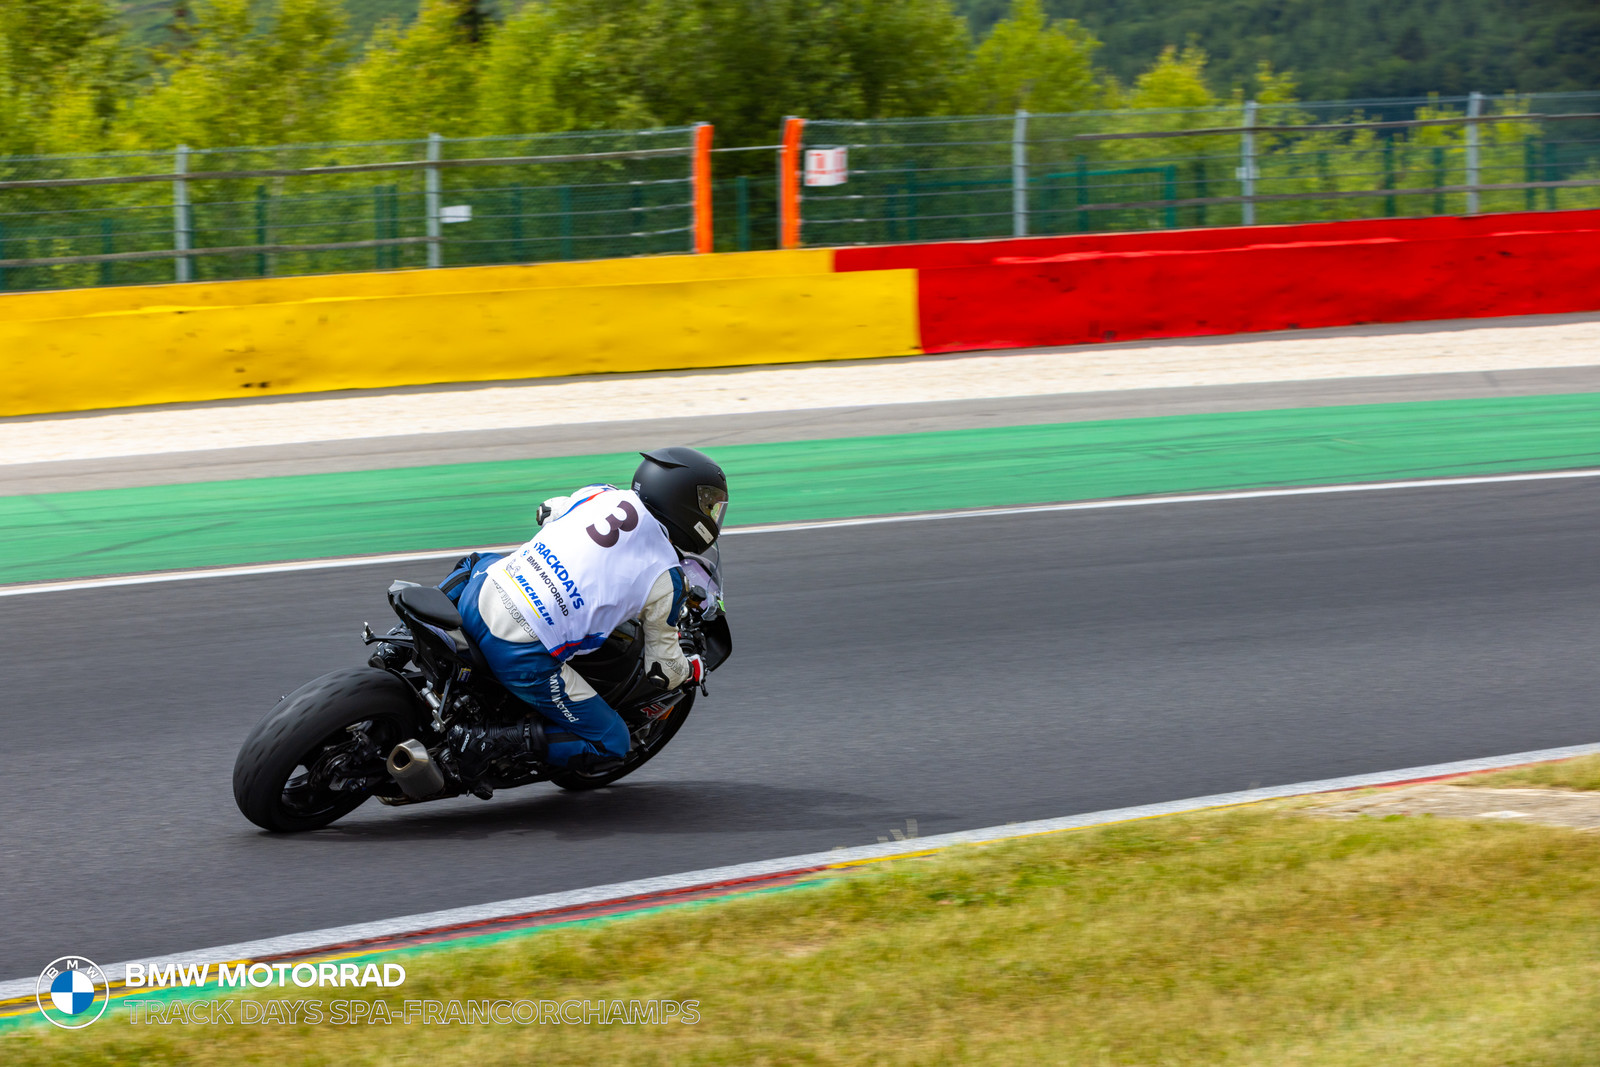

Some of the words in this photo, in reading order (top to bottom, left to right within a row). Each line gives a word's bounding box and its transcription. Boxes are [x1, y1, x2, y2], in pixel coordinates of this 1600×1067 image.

[586, 500, 639, 548] 3
[515, 574, 555, 626] MICHELIN
[526, 555, 543, 572] BMW
[539, 571, 569, 617] MOTORRAD
